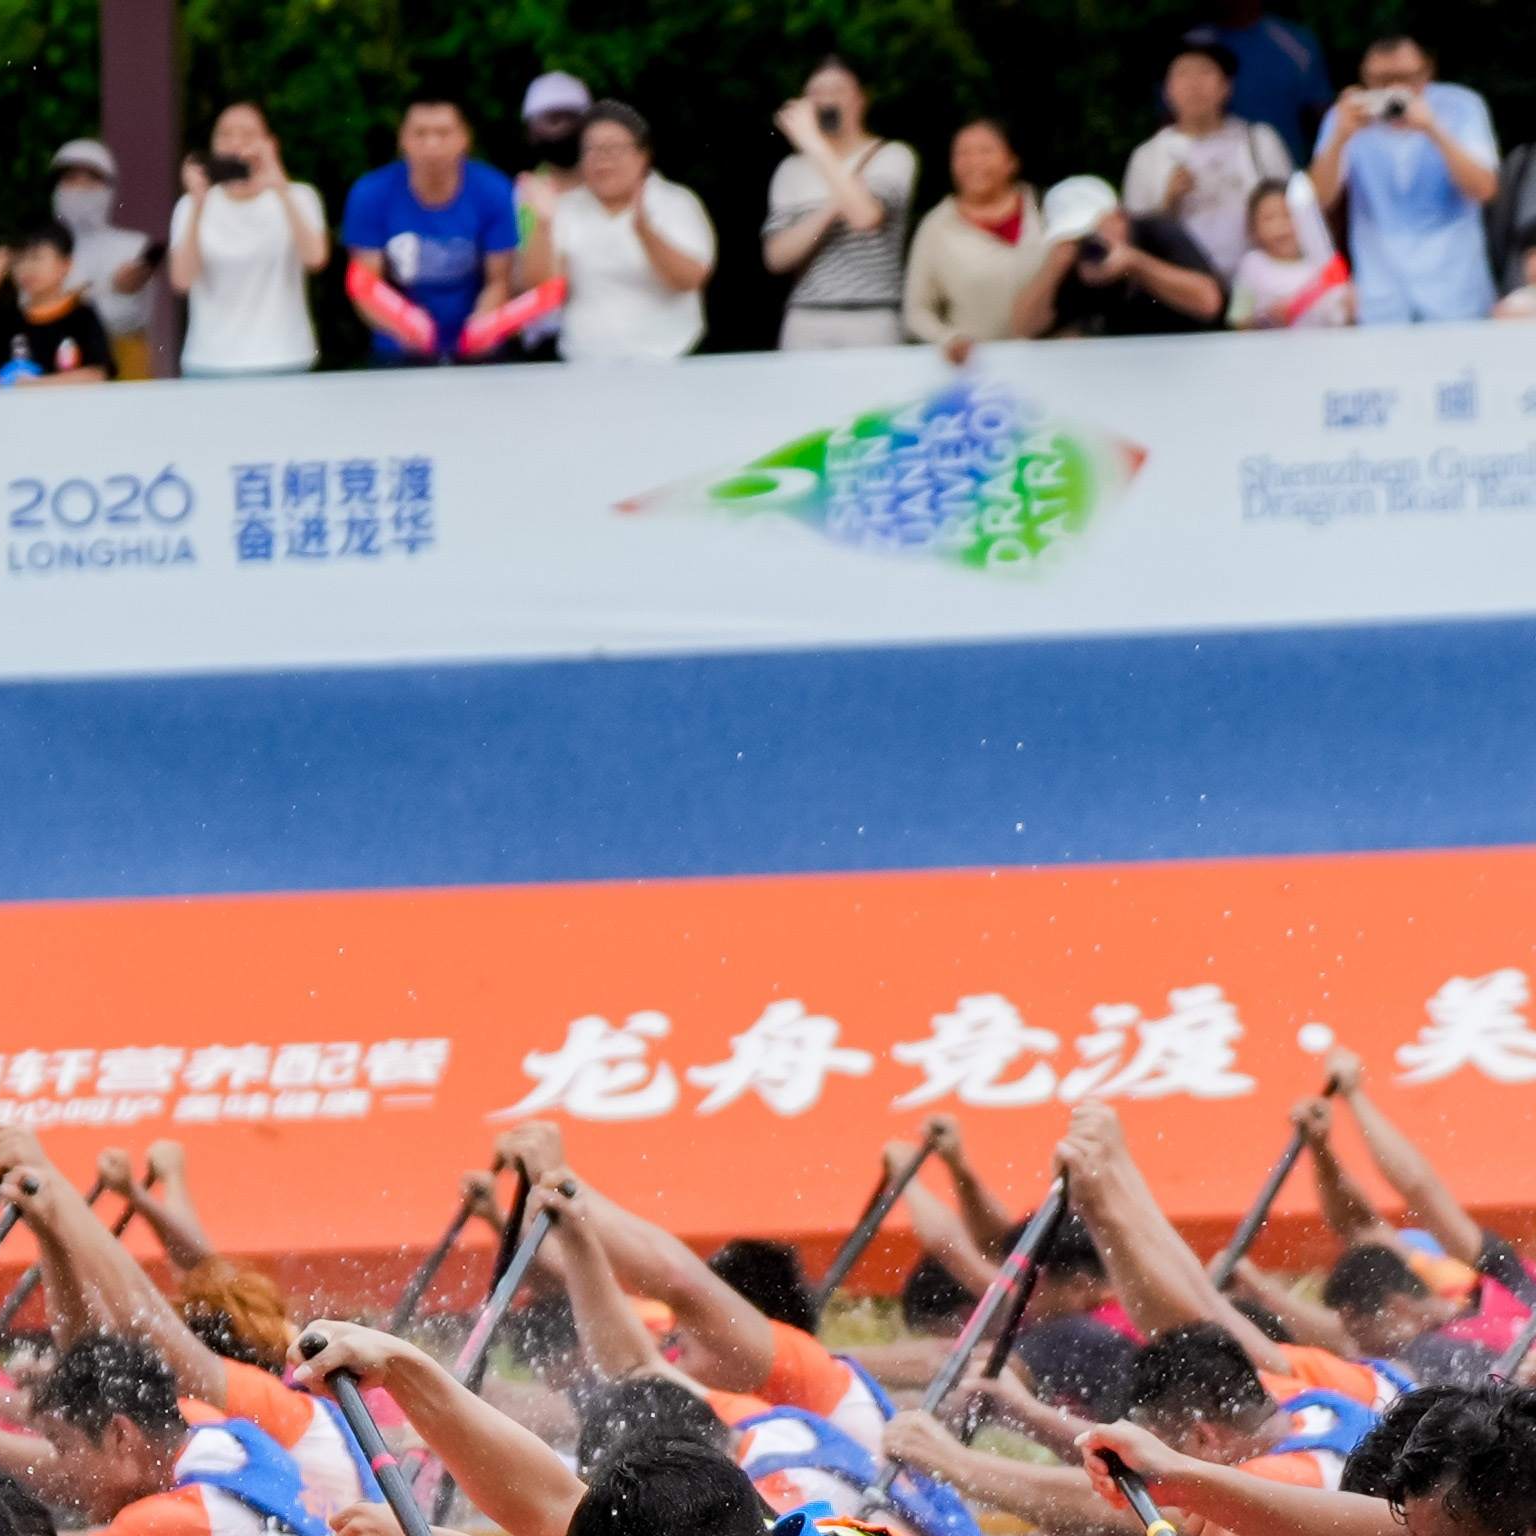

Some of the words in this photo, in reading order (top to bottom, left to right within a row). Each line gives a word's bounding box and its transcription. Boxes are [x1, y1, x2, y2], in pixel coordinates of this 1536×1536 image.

[7, 462, 196, 530] 2026
[231, 455, 434, 510] 百舸竞渡
[1240, 452, 1419, 490] Shenzhen
[1241, 484, 1378, 526] Dragon
[1385, 478, 1464, 514] Boat
[7, 535, 197, 572] LONGHUA
[234, 506, 435, 562] 奋进龙华
